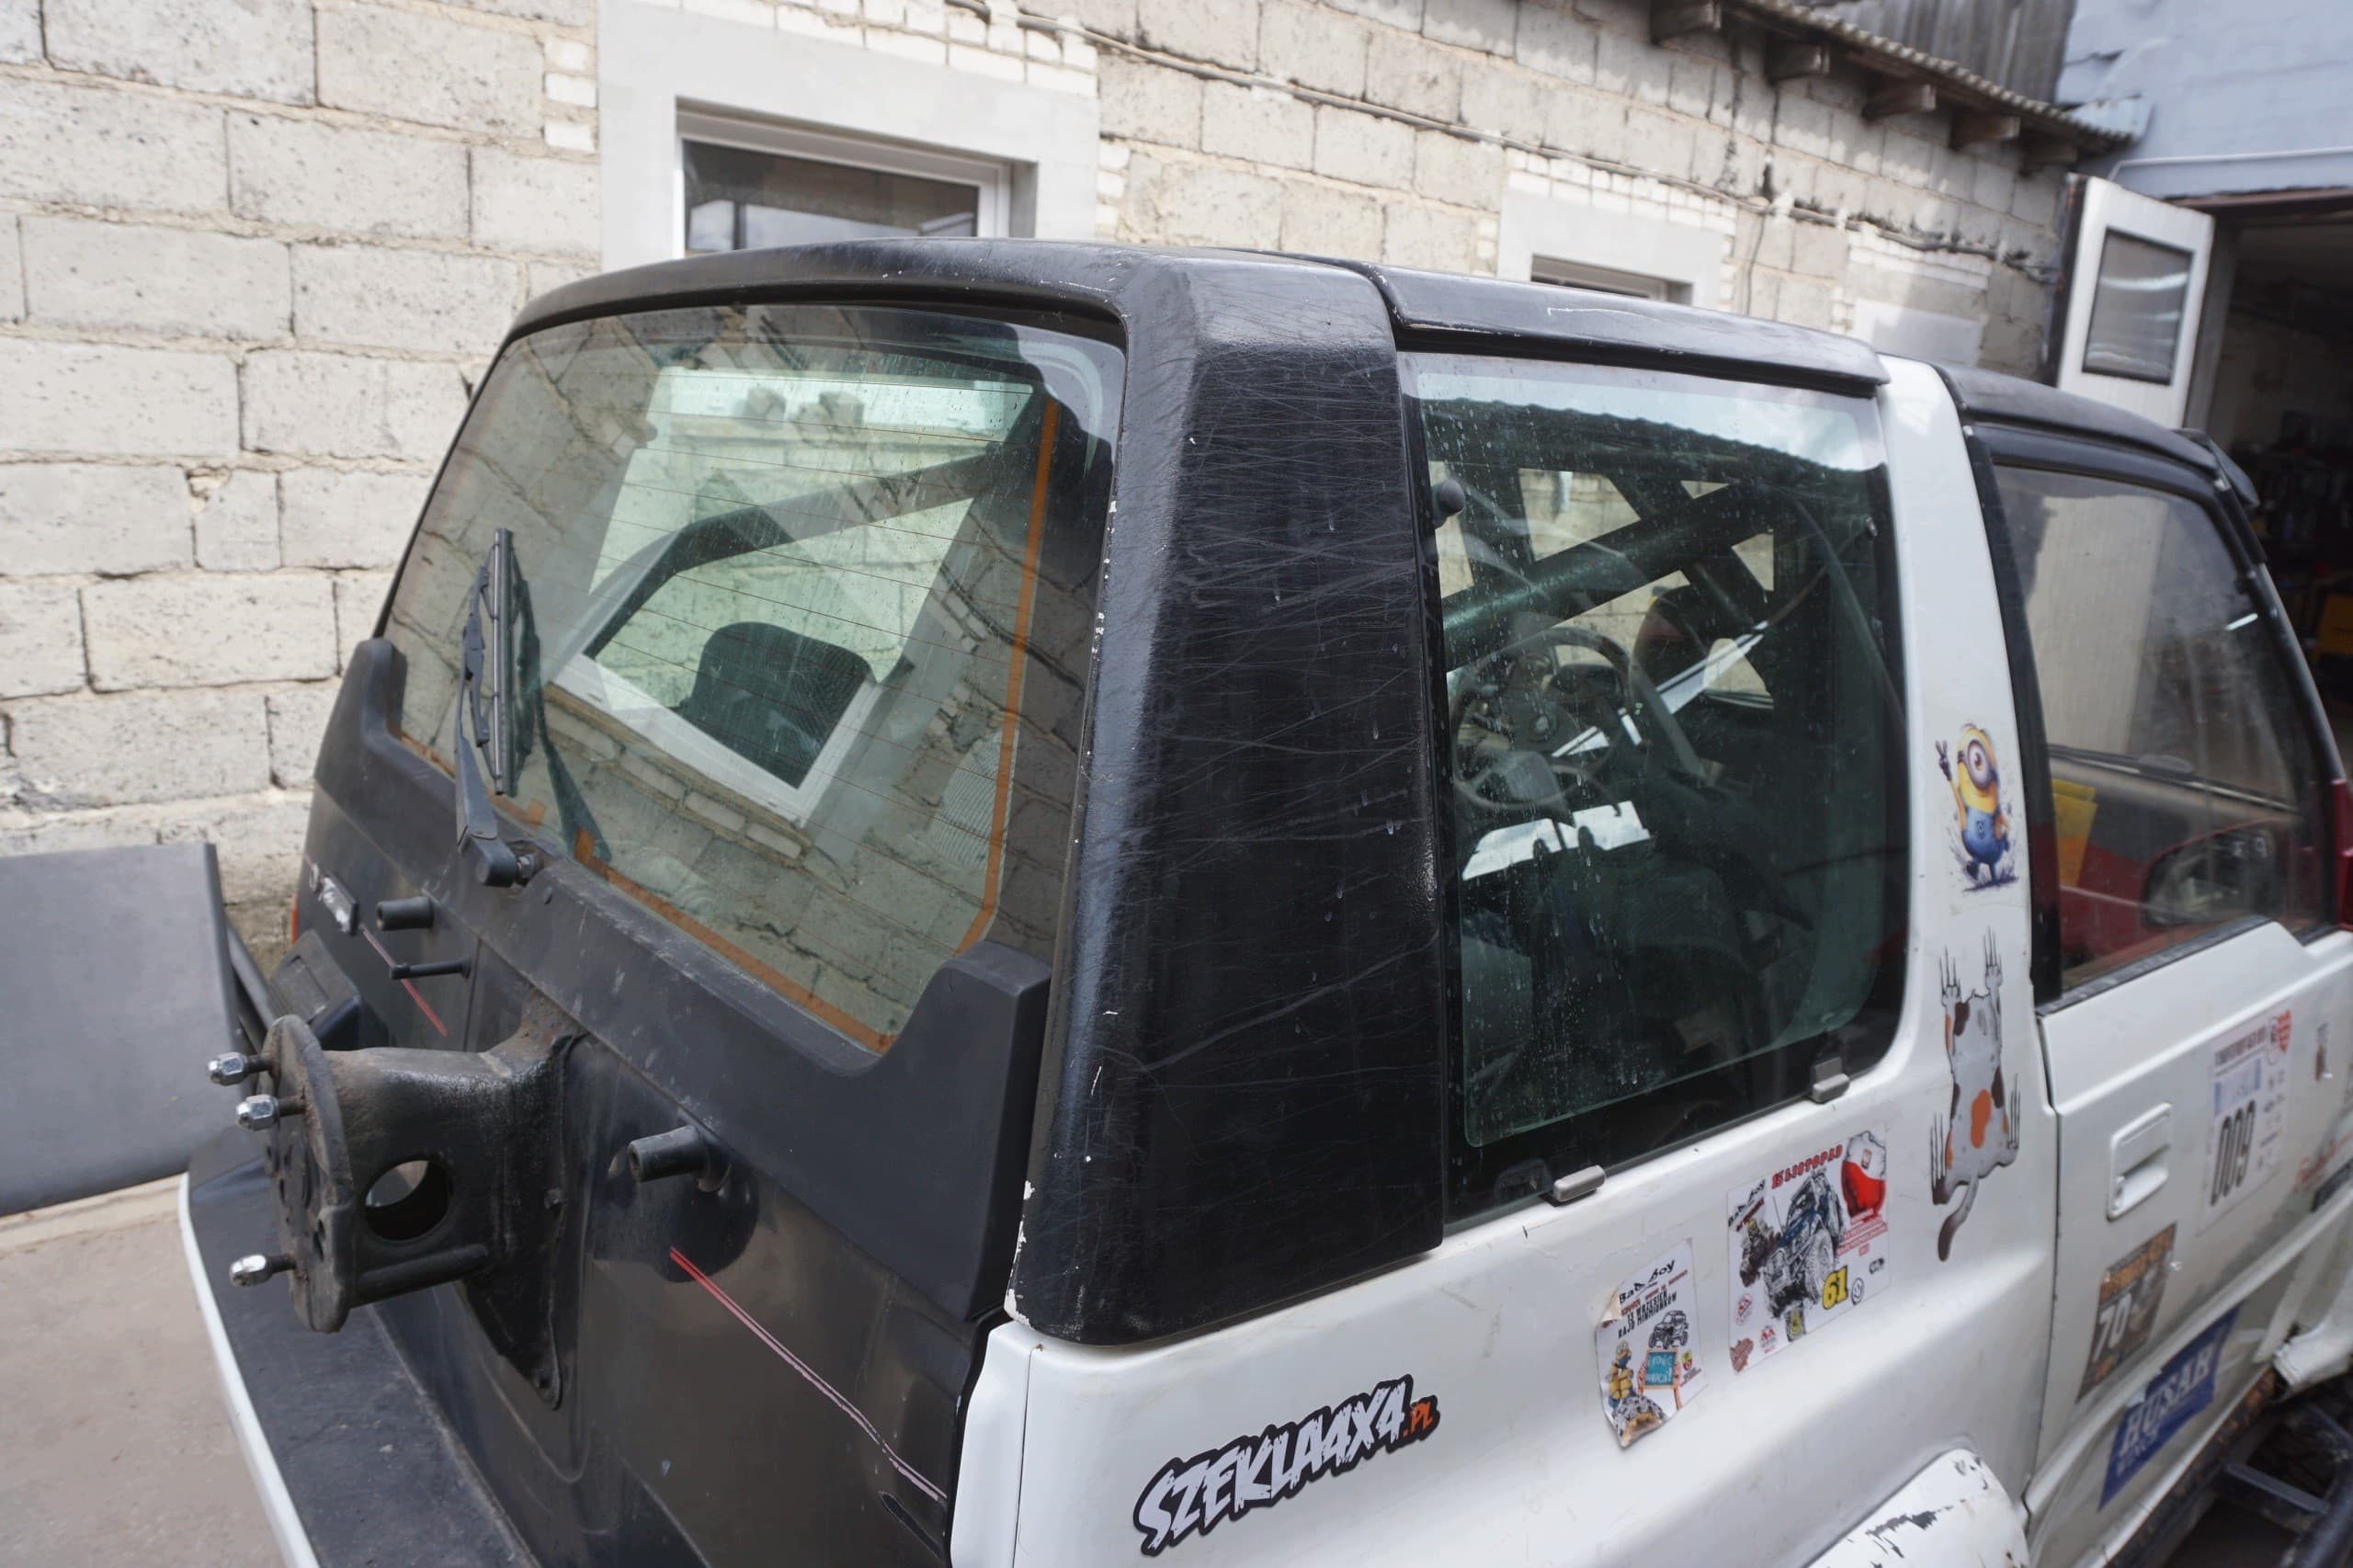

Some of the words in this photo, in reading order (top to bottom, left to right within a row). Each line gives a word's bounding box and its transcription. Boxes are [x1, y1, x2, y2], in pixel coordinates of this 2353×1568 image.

[1784, 1143, 1843, 1182] LISTOPAD
[1619, 1282, 1645, 1304] Bad
[1648, 1259, 1675, 1283] boy
[1823, 1265, 1848, 1311] 61
[2092, 1291, 2132, 1364] 70
[2120, 1342, 2214, 1457] HUSAR
